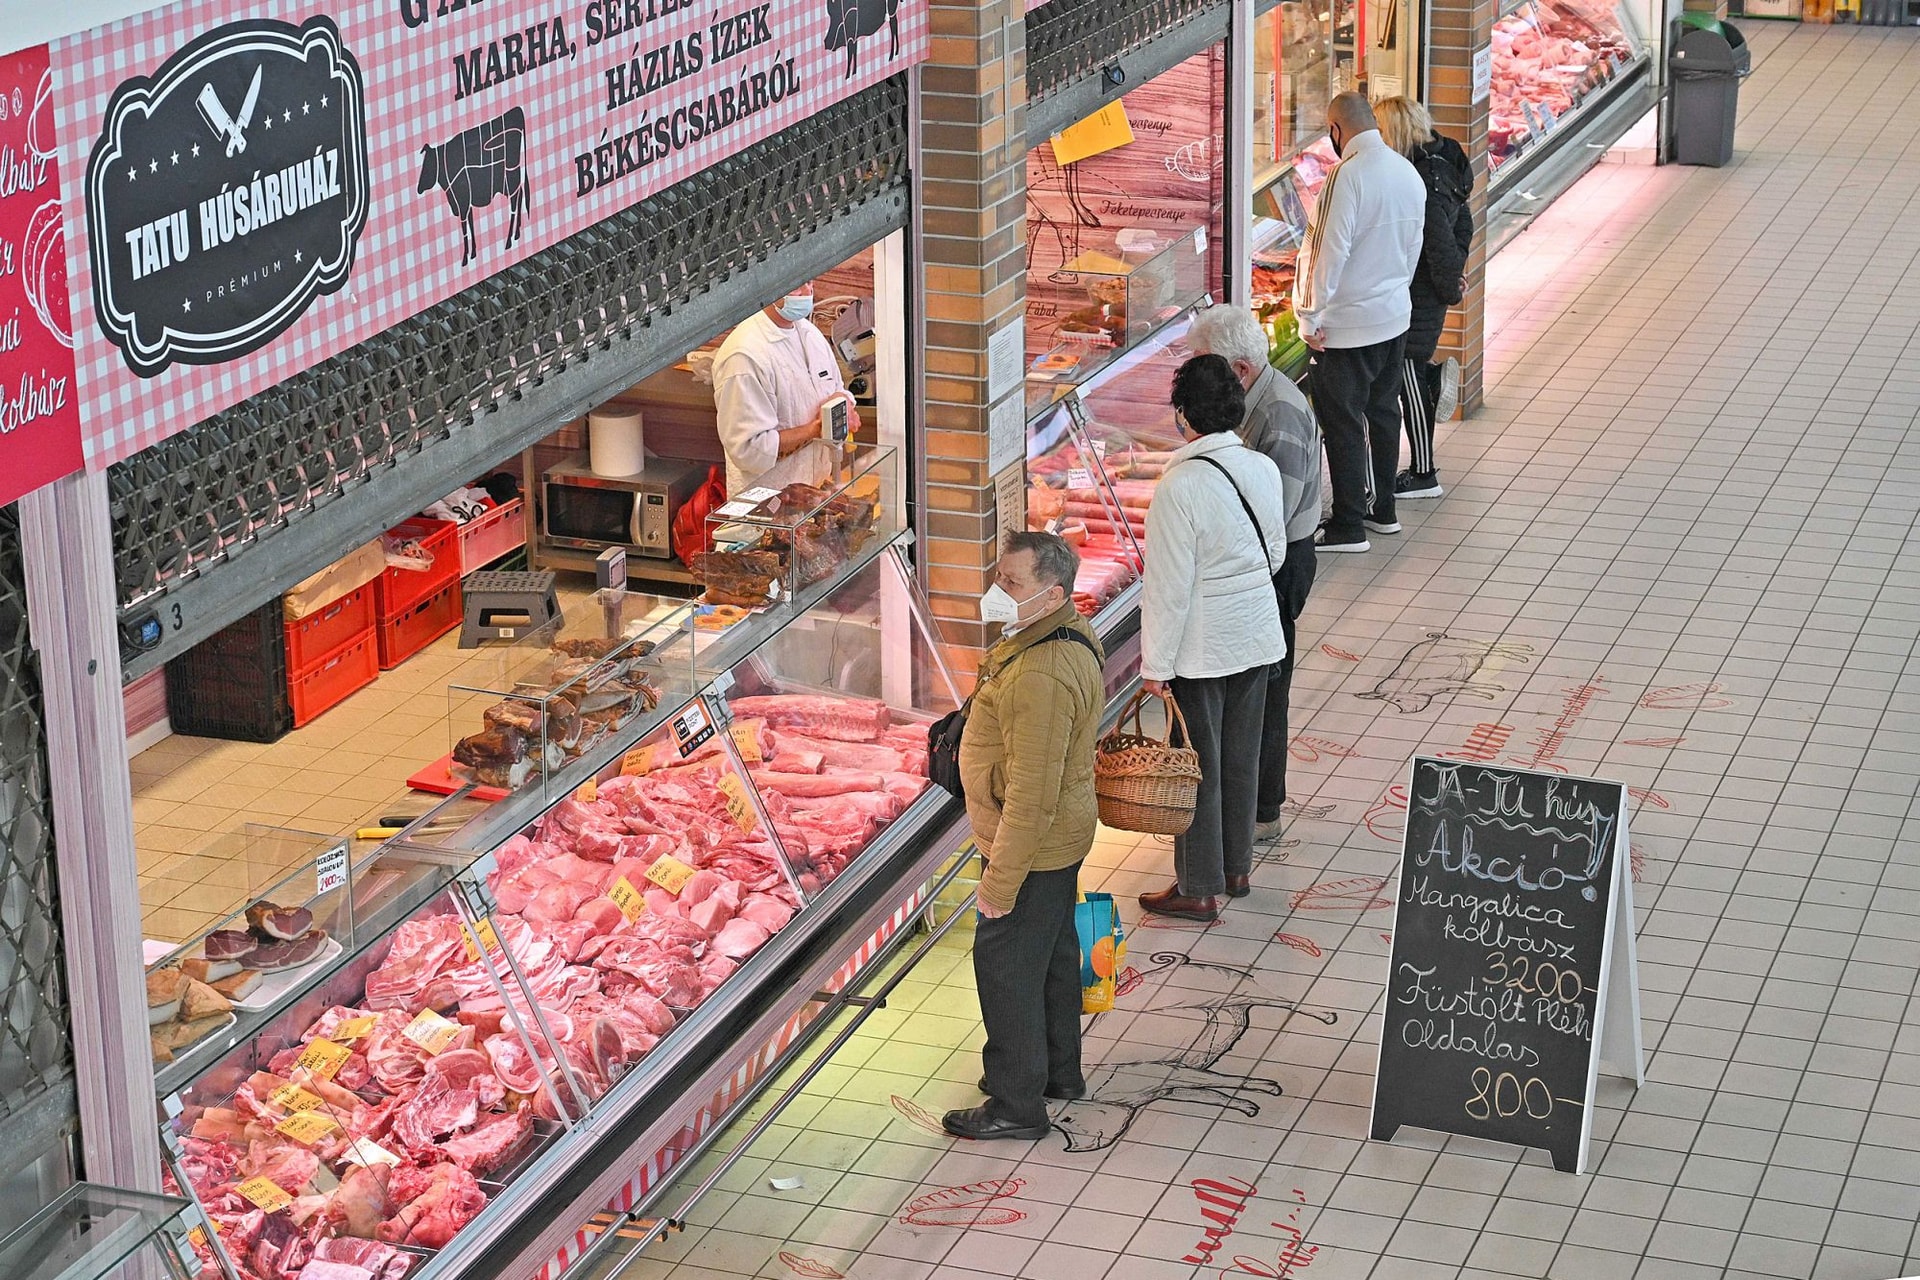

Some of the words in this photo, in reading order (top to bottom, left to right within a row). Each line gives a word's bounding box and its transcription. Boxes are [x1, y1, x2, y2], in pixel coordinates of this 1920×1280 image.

[453, 15, 577, 101] MARHA,
[585, 0, 694, 47] SERT
[605, 41, 704, 112] HÁZIAS
[710, 2, 772, 66] ÍZEK
[574, 57, 801, 198] BÉKÉSCSABÁRÓL
[0, 142, 48, 198] lbász
[124, 207, 191, 281] TATU
[199, 145, 342, 252] HÚSÁRUHÁZ
[1099, 199, 1187, 224] Feketepecsenye
[206, 262, 284, 304] PRÉMIUM
[171, 602, 184, 631] 3
[1415, 808, 1615, 903] Akció!
[1404, 874, 1576, 929] Mangalica
[1443, 914, 1577, 963] kolbász
[1397, 961, 1527, 1022] Füstölt
[1402, 1018, 1541, 1067] Oldalas
